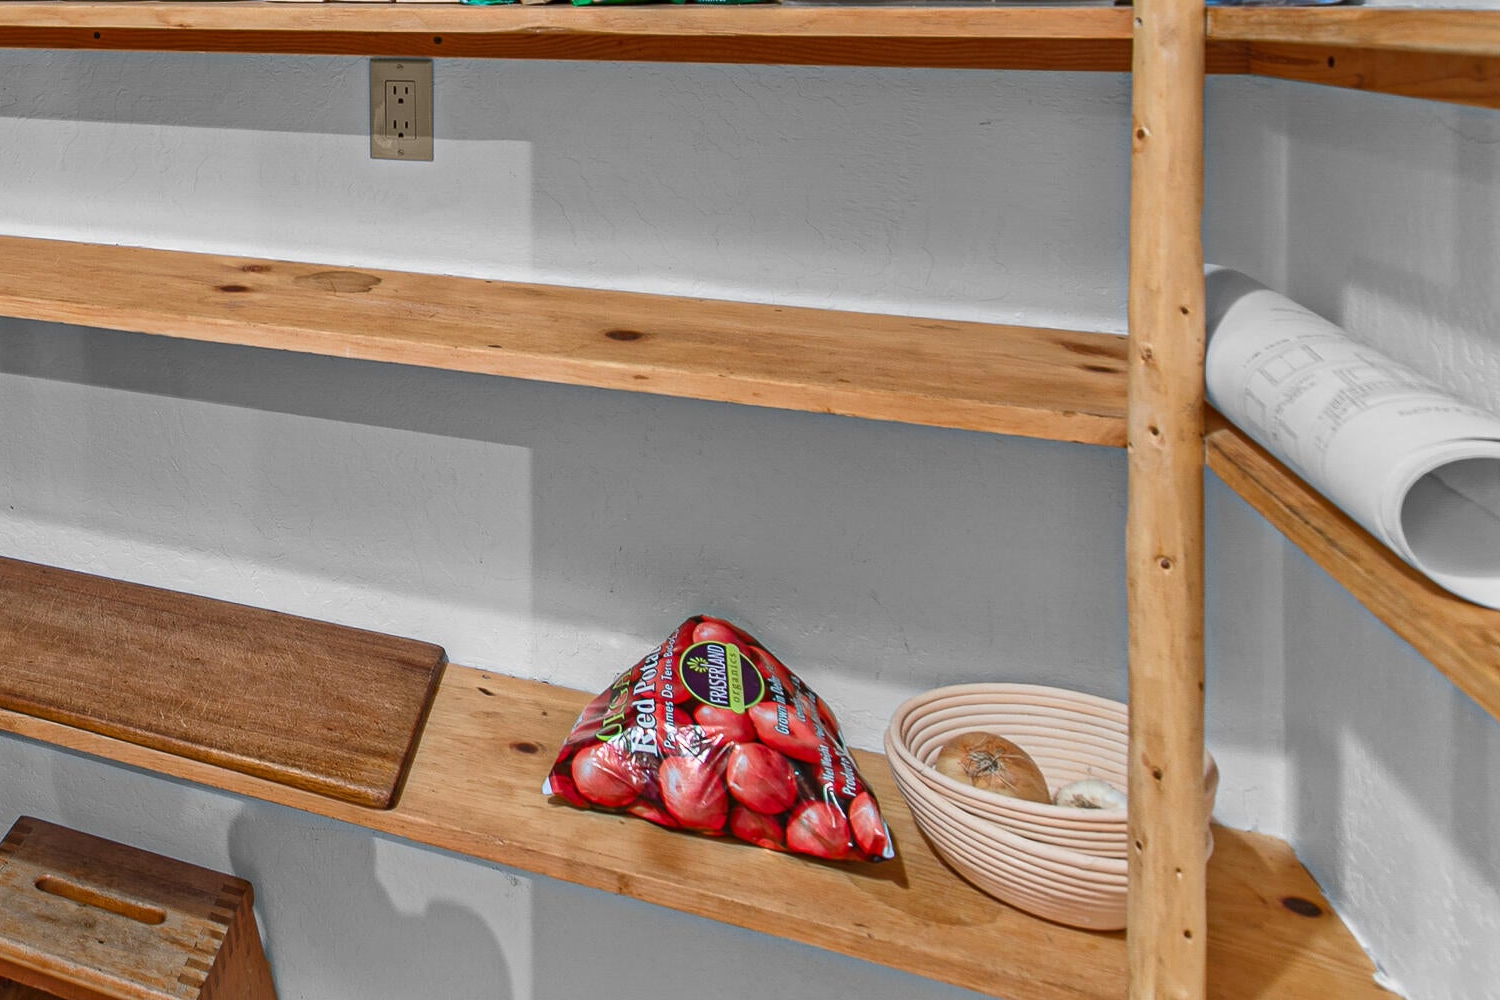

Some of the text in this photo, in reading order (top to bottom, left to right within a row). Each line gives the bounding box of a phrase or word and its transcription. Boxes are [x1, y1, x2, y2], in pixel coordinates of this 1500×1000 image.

[660, 683, 674, 699] De
[661, 659, 674, 681] Terre
[703, 644, 729, 704] FRASERLAND
[728, 652, 742, 704] organics
[630, 698, 659, 757] Red
[773, 694, 791, 735] Grown in
